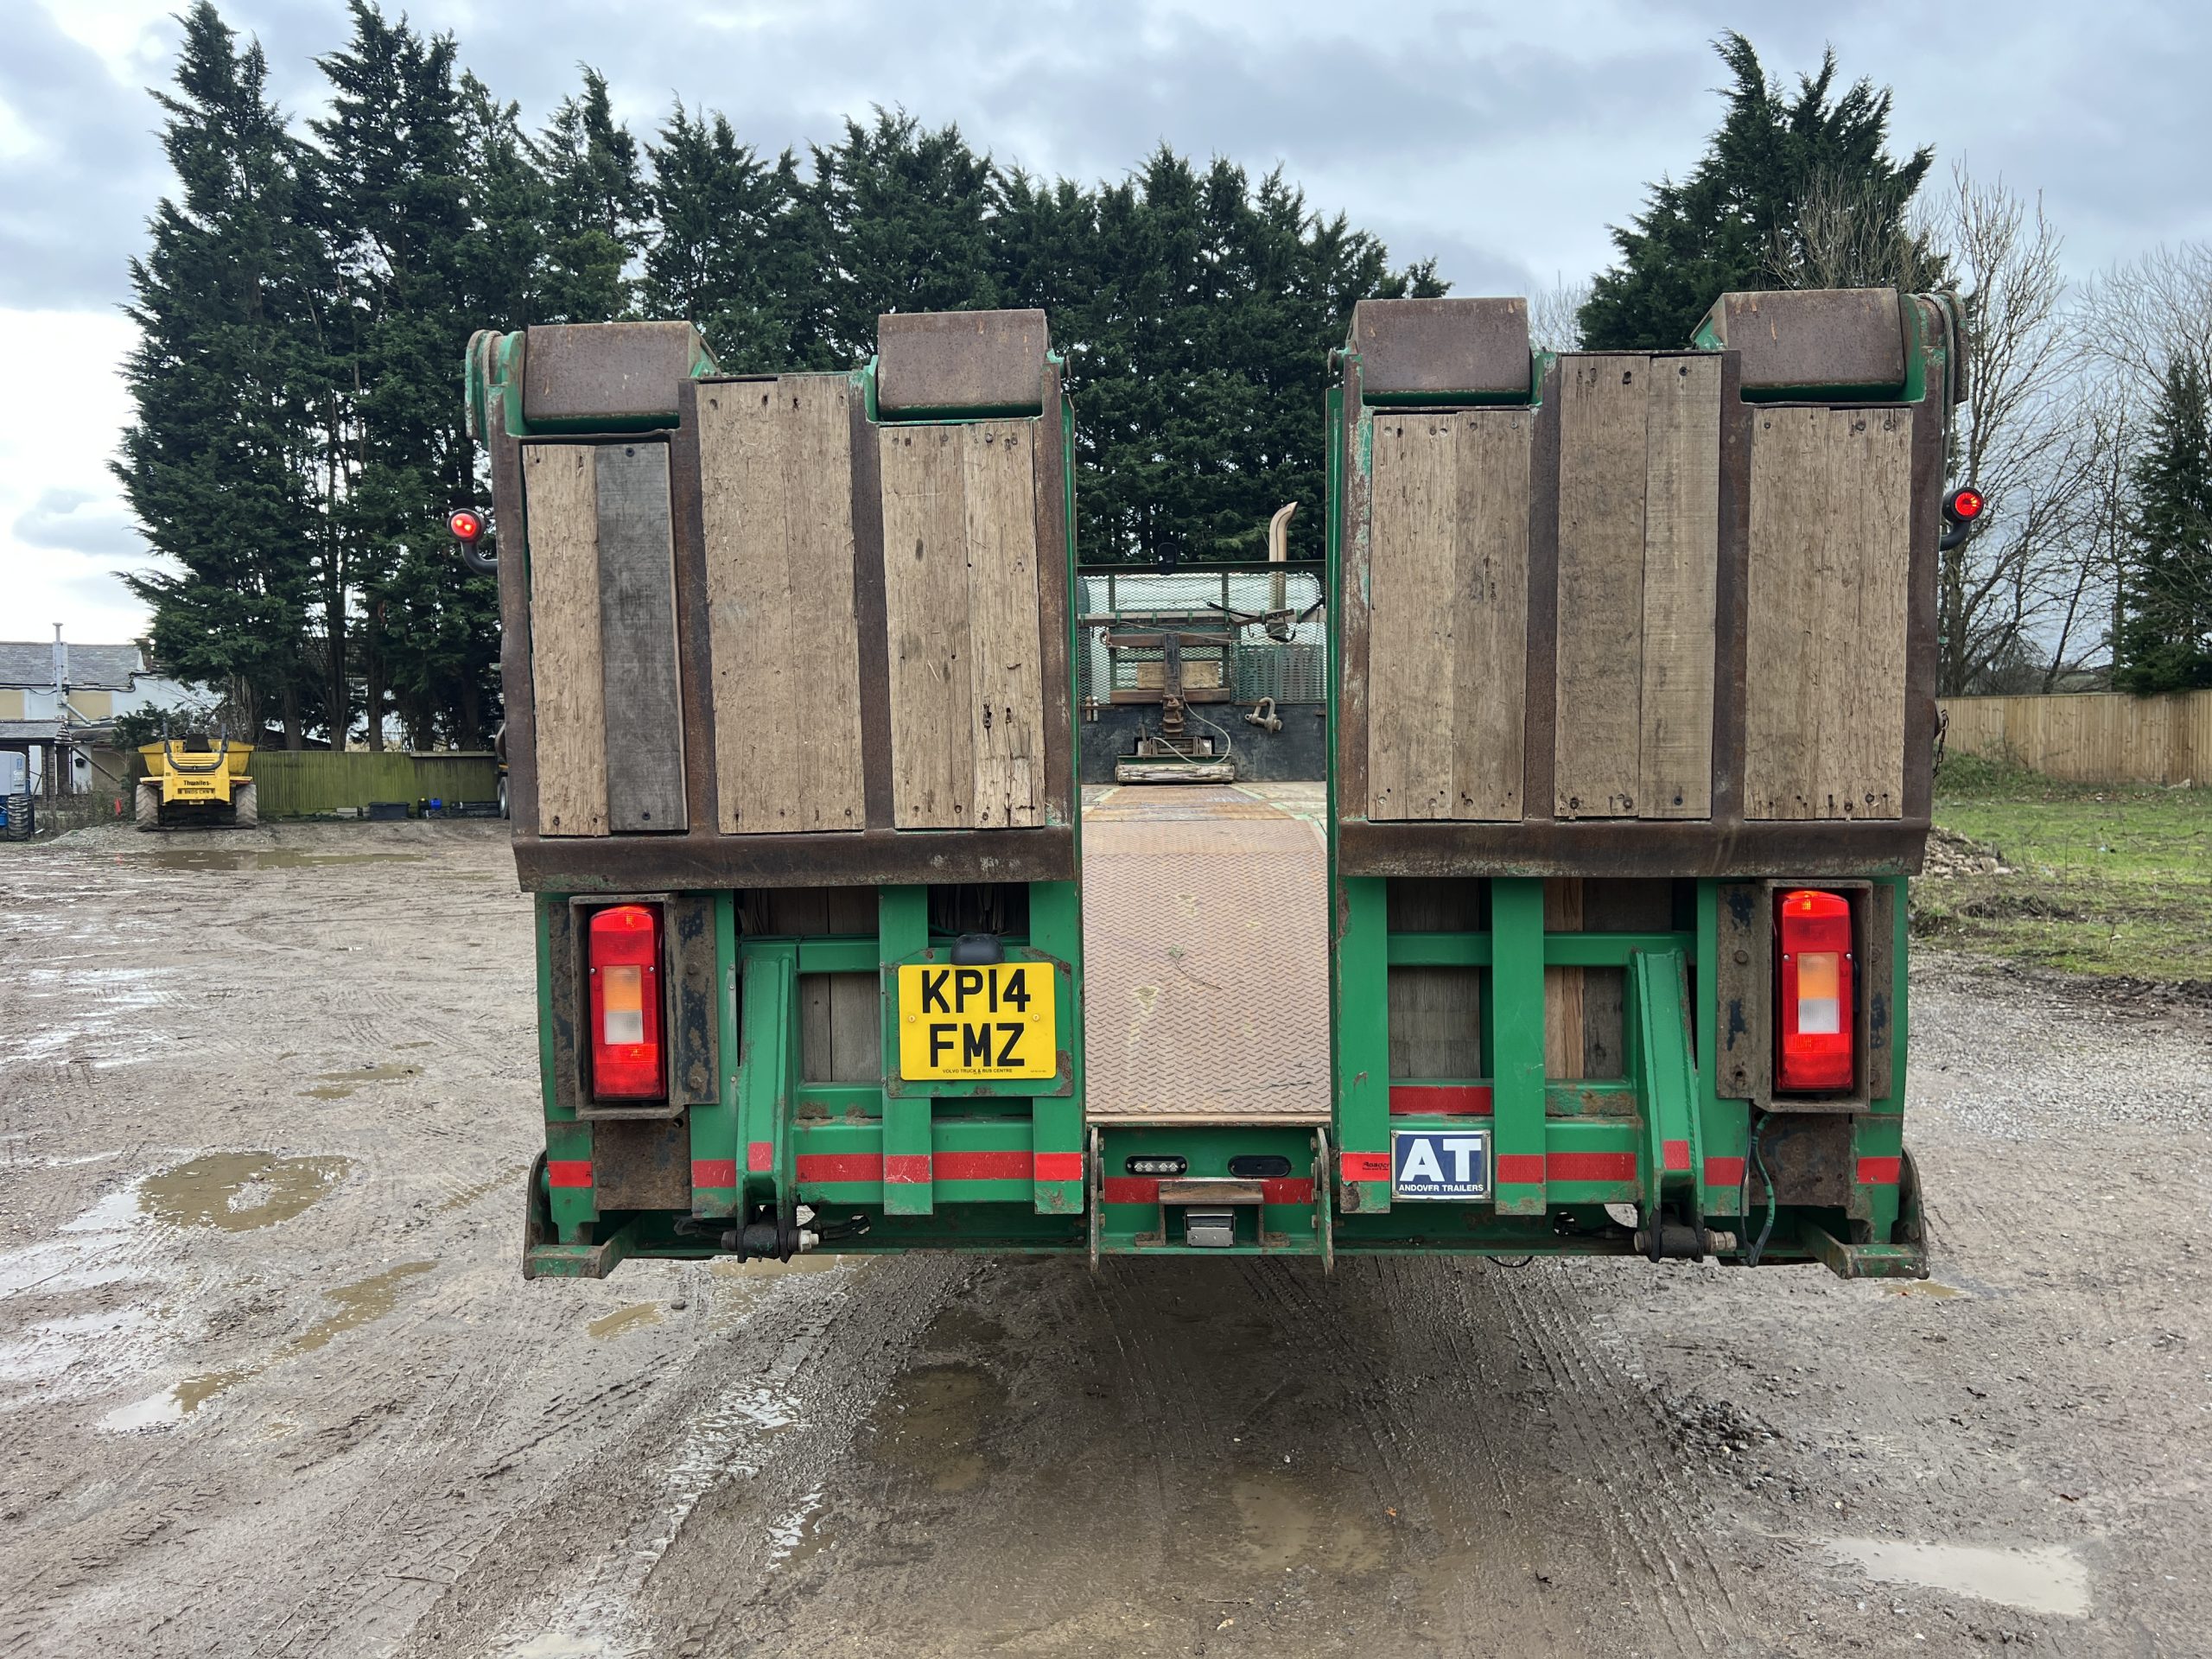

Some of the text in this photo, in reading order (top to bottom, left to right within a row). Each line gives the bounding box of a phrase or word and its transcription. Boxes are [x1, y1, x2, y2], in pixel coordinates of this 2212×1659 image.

[921, 969, 1031, 1014] KP14
[930, 1022, 1025, 1068] FMZ
[1399, 1138, 1481, 1182] AT
[1398, 1184, 1484, 1192] ANDOVER TRAILERS
